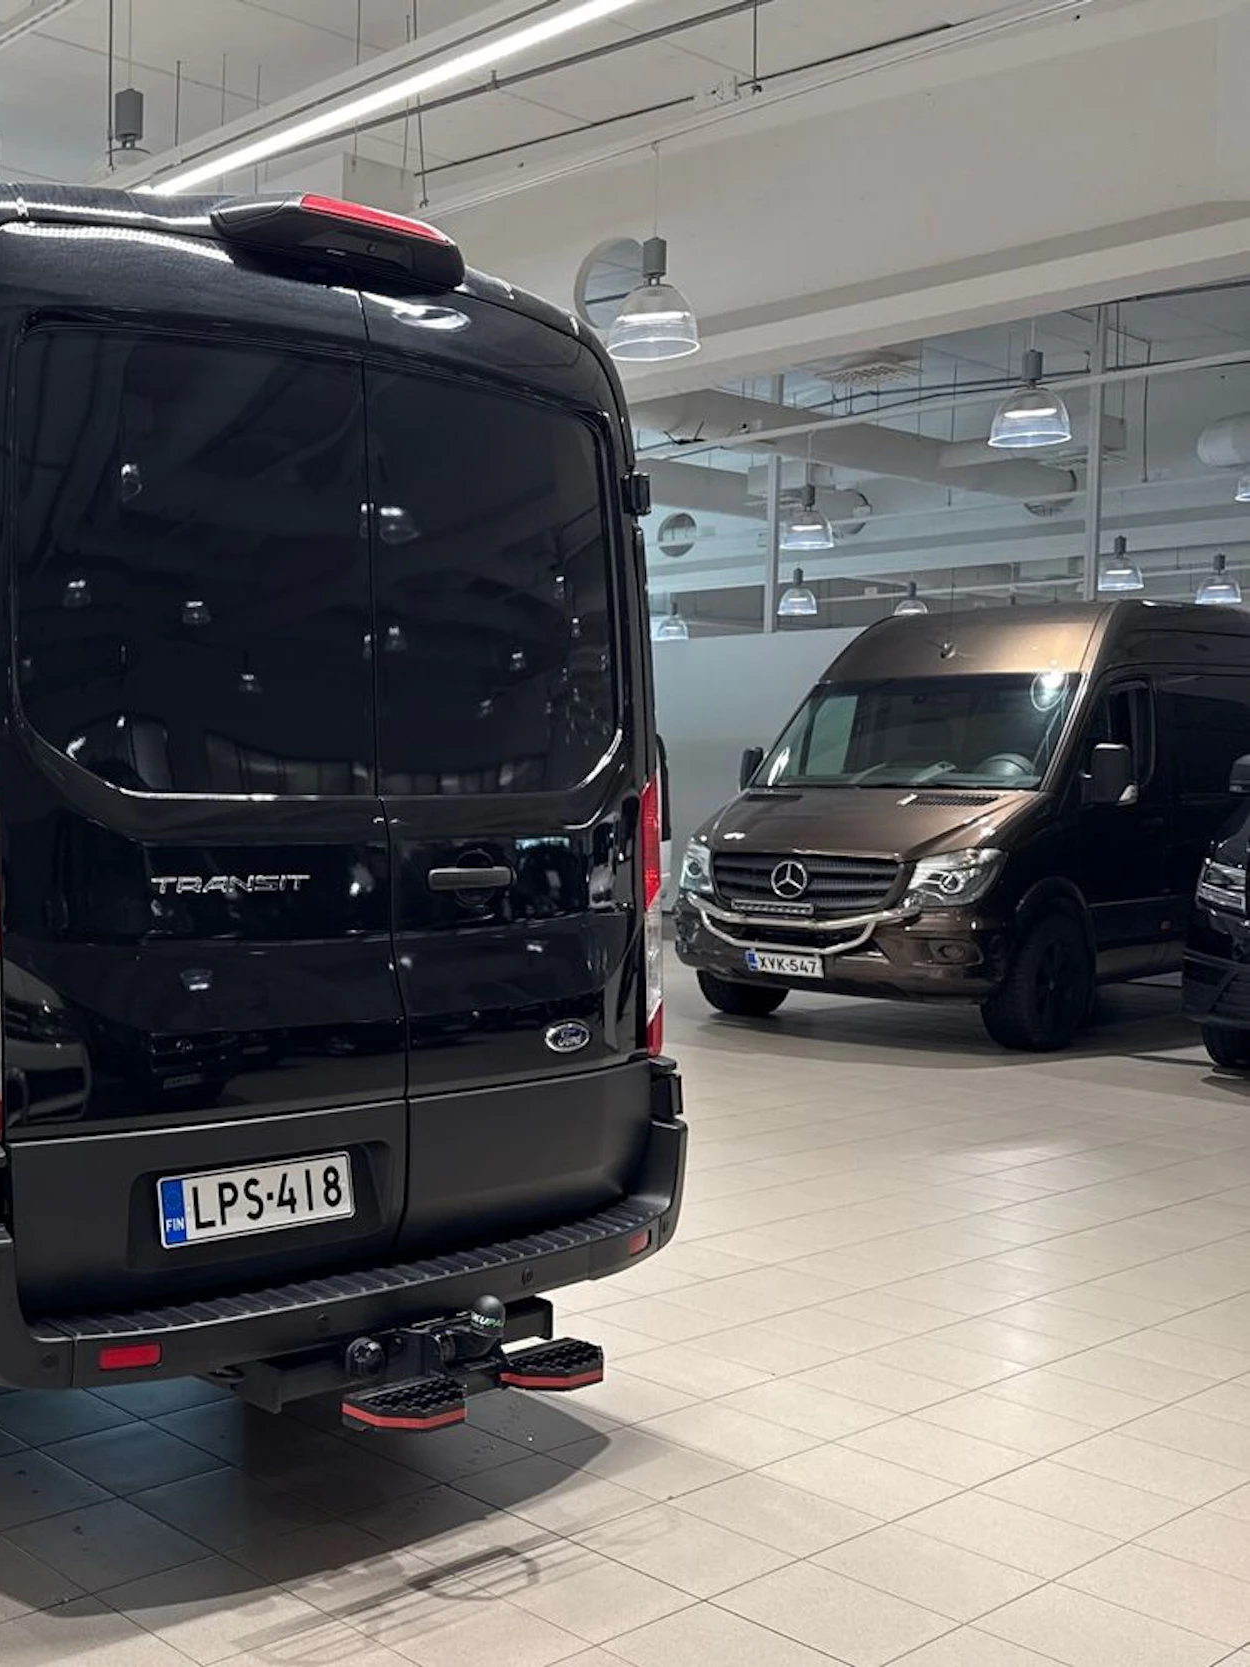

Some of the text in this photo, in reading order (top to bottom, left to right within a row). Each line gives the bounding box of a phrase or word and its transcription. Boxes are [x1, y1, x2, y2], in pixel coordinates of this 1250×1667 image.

[150, 874, 311, 894] TRANSIT
[556, 1028, 583, 1047] Ford
[192, 1166, 342, 1230] LPS-418
[165, 1217, 185, 1233] FIN
